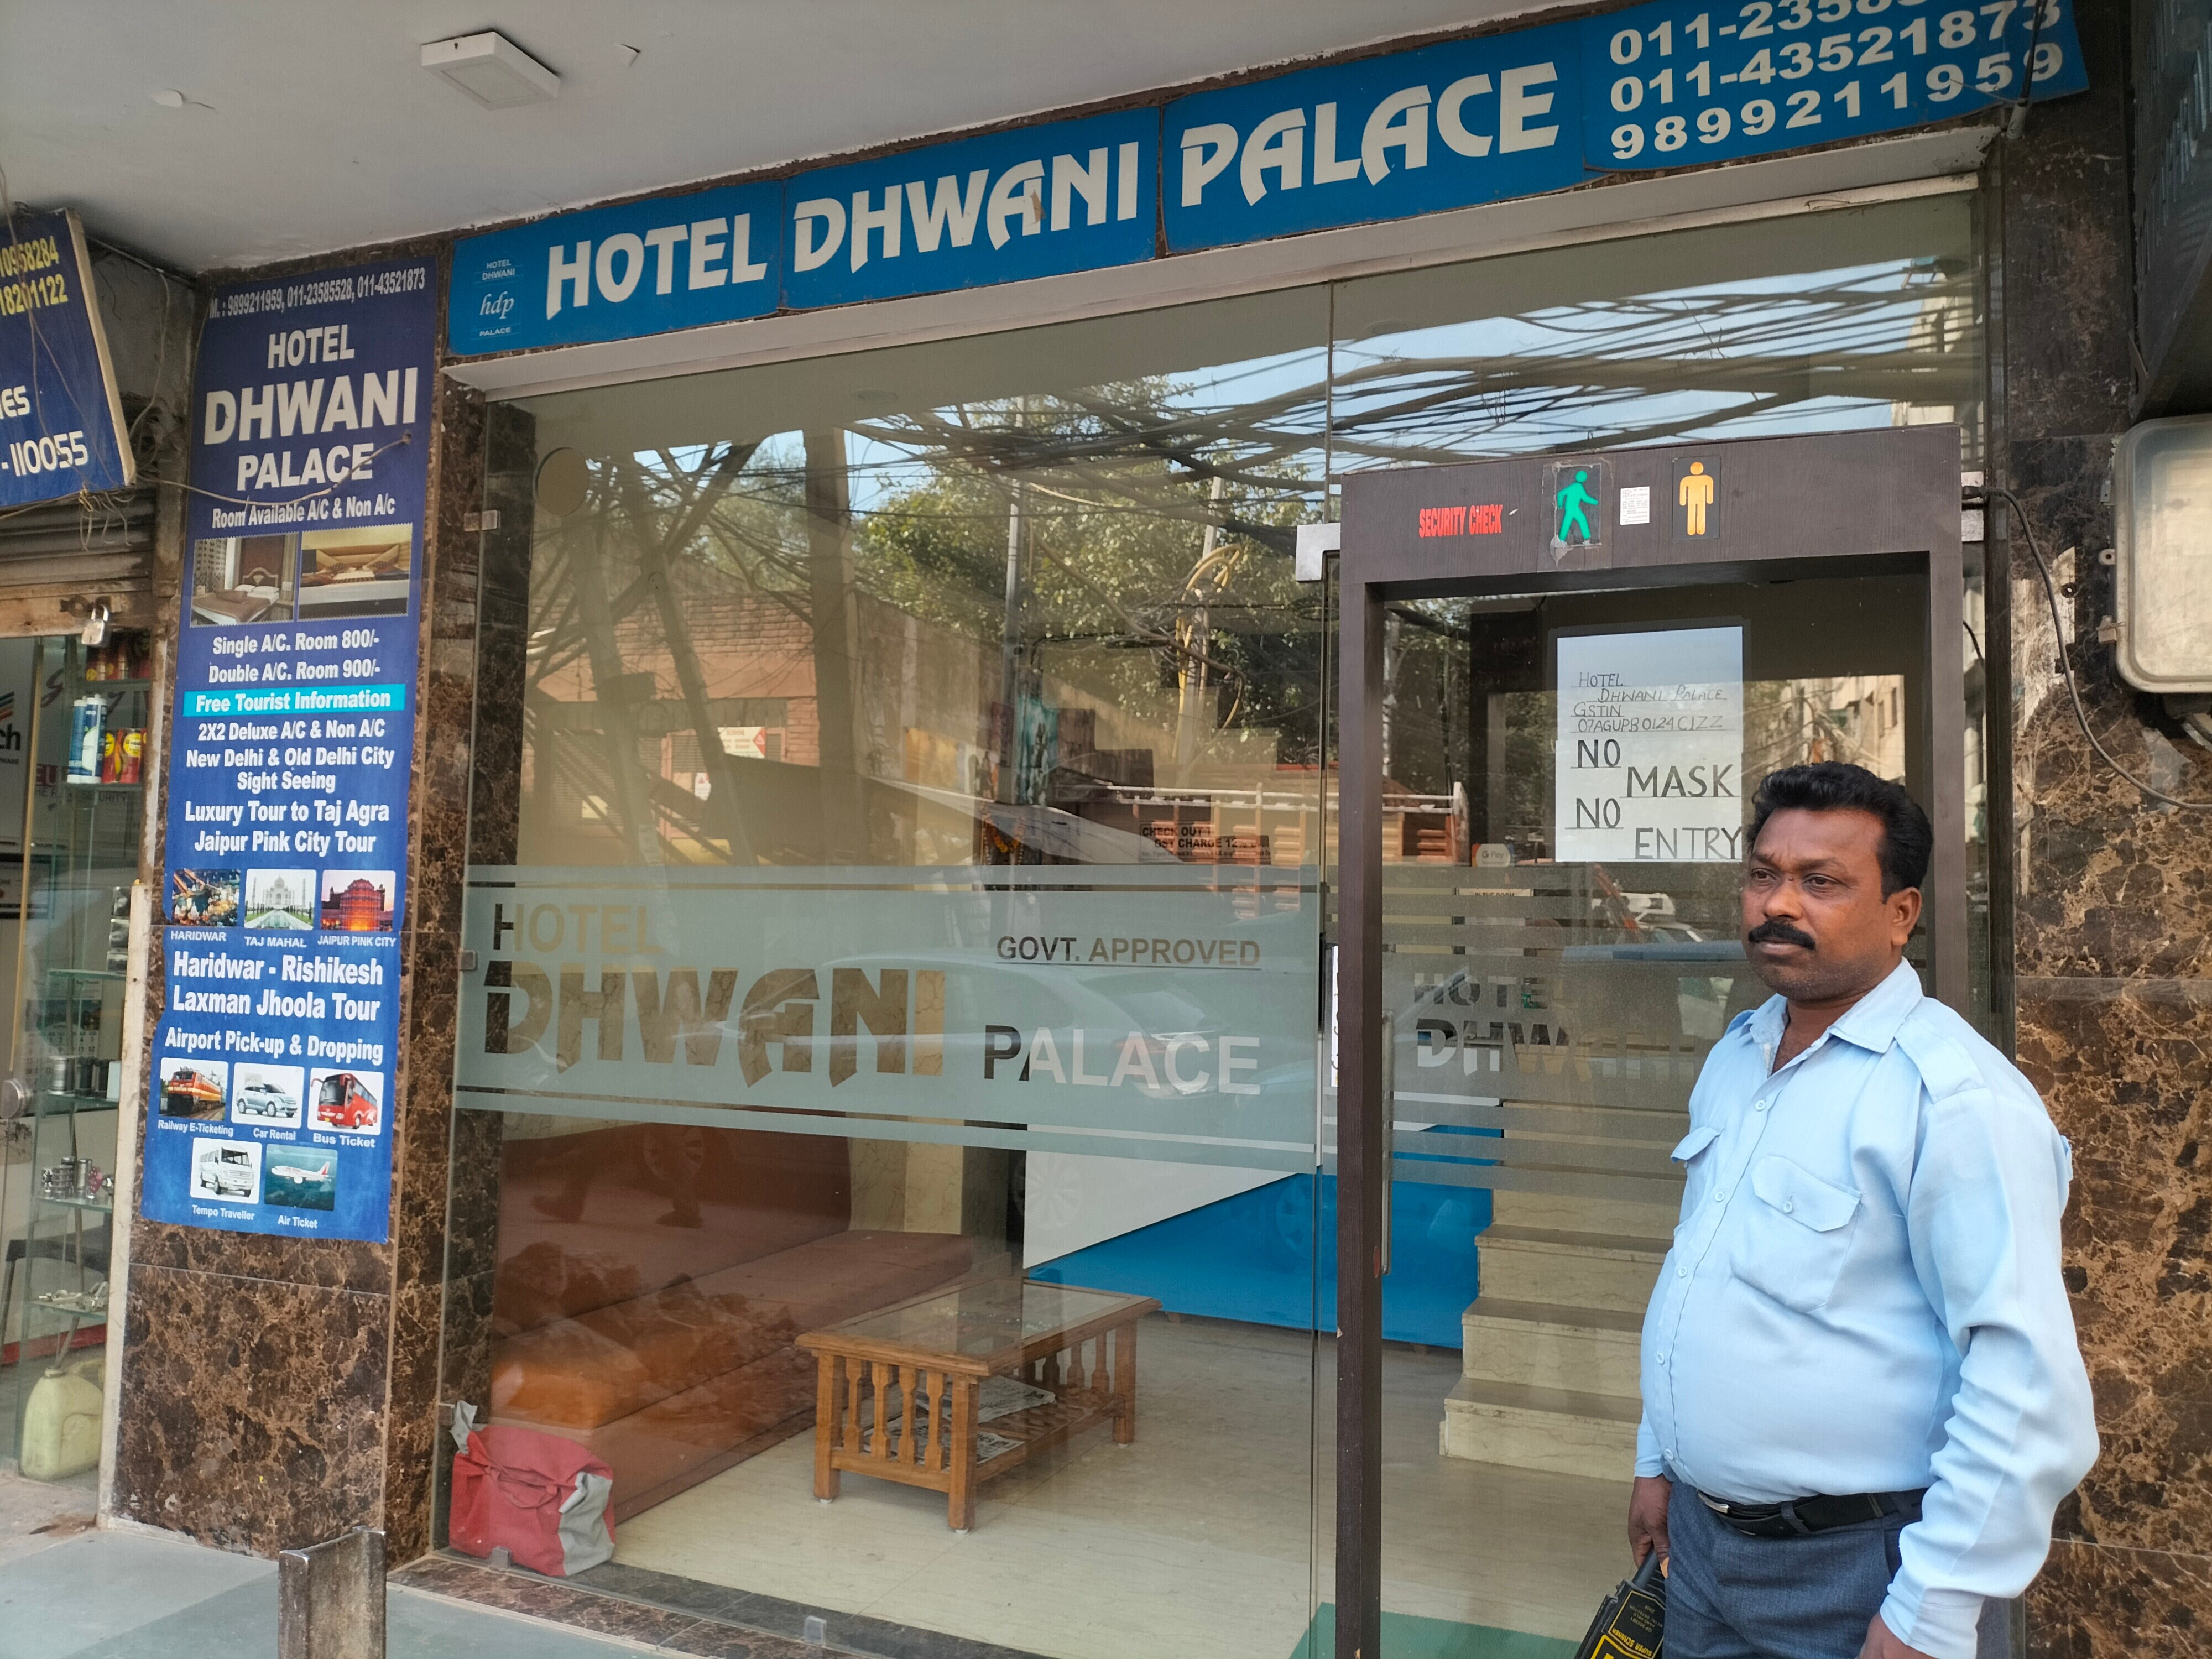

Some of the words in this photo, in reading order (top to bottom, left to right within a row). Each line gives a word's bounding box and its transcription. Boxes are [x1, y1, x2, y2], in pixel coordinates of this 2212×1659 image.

[1610, 0, 2061, 112] 011-43521873
[1610, 42, 2063, 160] 9899211959
[546, 213, 768, 321] HOTEL
[793, 141, 1139, 274] DHWANI
[1180, 61, 1560, 207] PALACE
[482, 268, 515, 281] DHWANI
[486, 259, 512, 269] HOTEL
[228, 288, 284, 316] 9899211959,
[287, 278, 354, 308] 011-23585528,
[357, 267, 425, 298] 011-43521873
[479, 327, 512, 337] PALACE
[267, 324, 354, 369] HOTEL
[0, 385, 30, 419] ES
[204, 367, 418, 445] DHWANI
[237, 442, 374, 492] PALACE
[212, 508, 246, 529] Room
[248, 502, 304, 526] Available
[307, 499, 328, 521] A/C
[332, 497, 342, 519] &
[346, 497, 373, 518] Non
[1418, 506, 1467, 539] SECURITY
[1469, 504, 1503, 535] CHECK
[213, 634, 257, 658] Single
[261, 634, 291, 653] A/C.
[295, 632, 338, 650] Room
[342, 629, 379, 648] 800/-
[208, 664, 258, 683] Double
[262, 662, 292, 682] A/C.
[296, 661, 338, 680] Room
[343, 659, 380, 677] 900/-
[1579, 672, 1624, 687] HOTEL
[196, 695, 230, 713] Free
[235, 692, 291, 711] Tourist
[295, 689, 391, 709] Information
[1597, 688, 1667, 703] DHWANI
[1674, 684, 1724, 701] PALACE
[1573, 701, 1622, 718] GSTIN
[198, 723, 226, 742] 2X2
[229, 722, 278, 740] Deluxe
[281, 721, 305, 739] A/C
[310, 720, 322, 738] &
[326, 719, 356, 738] Non
[359, 718, 385, 737] A/C
[186, 749, 221, 768] New
[224, 748, 263, 767] Delhi
[268, 748, 280, 766] &
[285, 747, 311, 766] Old
[315, 747, 356, 766] Delhi
[361, 746, 395, 769] City
[1577, 739, 1621, 768] NO
[237, 771, 278, 794] Sight
[281, 771, 336, 793] Seeing
[1627, 764, 1735, 798] MASK
[185, 800, 243, 827] Luxury
[247, 800, 287, 821] Tour
[291, 801, 310, 822] to
[314, 800, 342, 826] Taj
[345, 800, 389, 827] Agra
[1576, 797, 1621, 830] NO
[194, 830, 248, 856] Jaipur
[252, 830, 291, 852] Pink
[295, 830, 331, 857] City
[334, 831, 377, 852] Tour
[1178, 838, 1222, 848] CHARGE
[1635, 826, 1742, 860] ENTRY
[170, 930, 227, 942] HARIDWAR
[317, 935, 350, 946] JAIPUR
[351, 936, 374, 947] PINK
[374, 937, 397, 947] CITY
[493, 902, 665, 954] HOTEL
[244, 936, 265, 946] TAJ
[267, 936, 307, 948] MAHAL
[997, 936, 1080, 962] GOVT.
[1088, 937, 1261, 966] APPROVED
[173, 950, 265, 980] Haridwar
[281, 954, 383, 985] Rishikesh
[173, 985, 251, 1015] Laxman
[256, 989, 325, 1019] Jhoola
[332, 992, 381, 1021] Tour
[483, 959, 946, 1088] DHWANI
[165, 1027, 221, 1053] Airport
[225, 1030, 284, 1059] Pick-up
[289, 1034, 302, 1056] &
[307, 1035, 384, 1066] Dropping
[983, 1024, 1261, 1095] PALACE
[158, 1119, 188, 1133] Railway
[189, 1123, 234, 1137] E-Ticketing
[253, 1128, 269, 1139] Car
[269, 1129, 296, 1141] Rental
[313, 1133, 336, 1145] Bus
[339, 1135, 375, 1149] Ticket
[191, 1204, 219, 1219] Tempo
[220, 1207, 255, 1221] Traveller
[278, 1215, 291, 1226] Air
[291, 1217, 318, 1229] Ticket
[1612, 1627, 1635, 1647] SCANNER
[1635, 1643, 1653, 1657] SUPER
